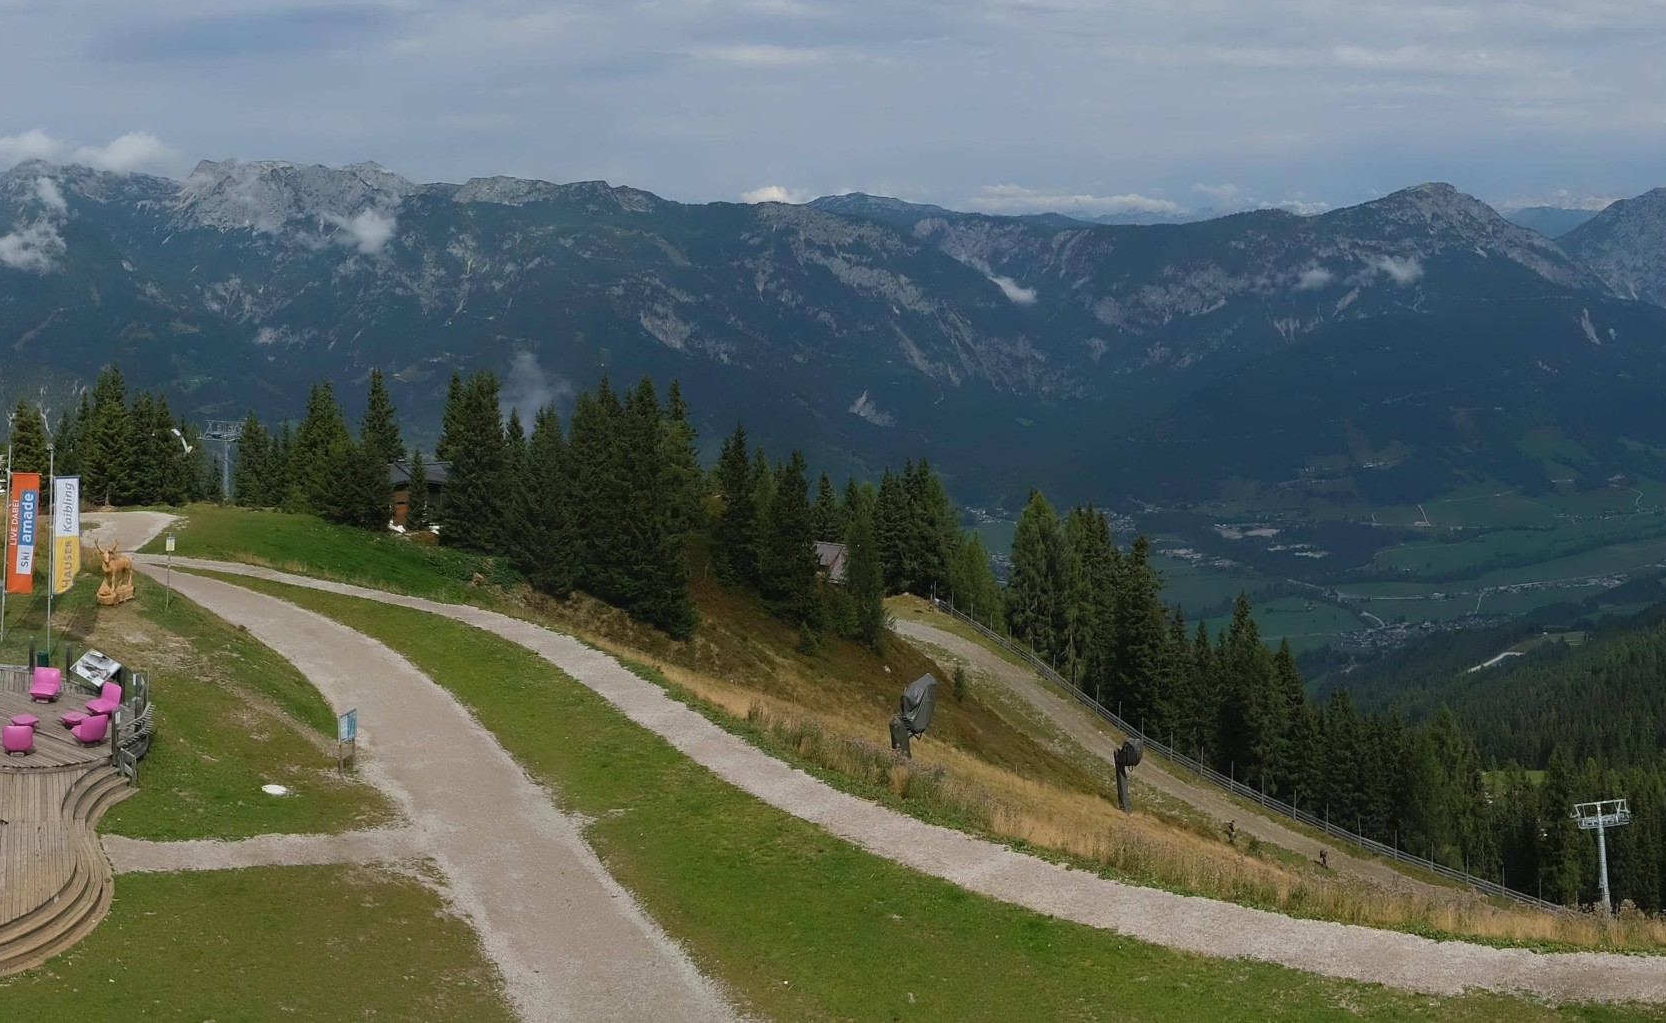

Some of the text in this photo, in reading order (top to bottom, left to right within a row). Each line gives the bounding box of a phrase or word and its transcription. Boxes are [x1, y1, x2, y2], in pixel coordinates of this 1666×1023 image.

[9, 499, 20, 546] LIVE DABEI
[20, 493, 34, 567] Ski amade
[62, 482, 75, 589] HAUSER Kaibling
